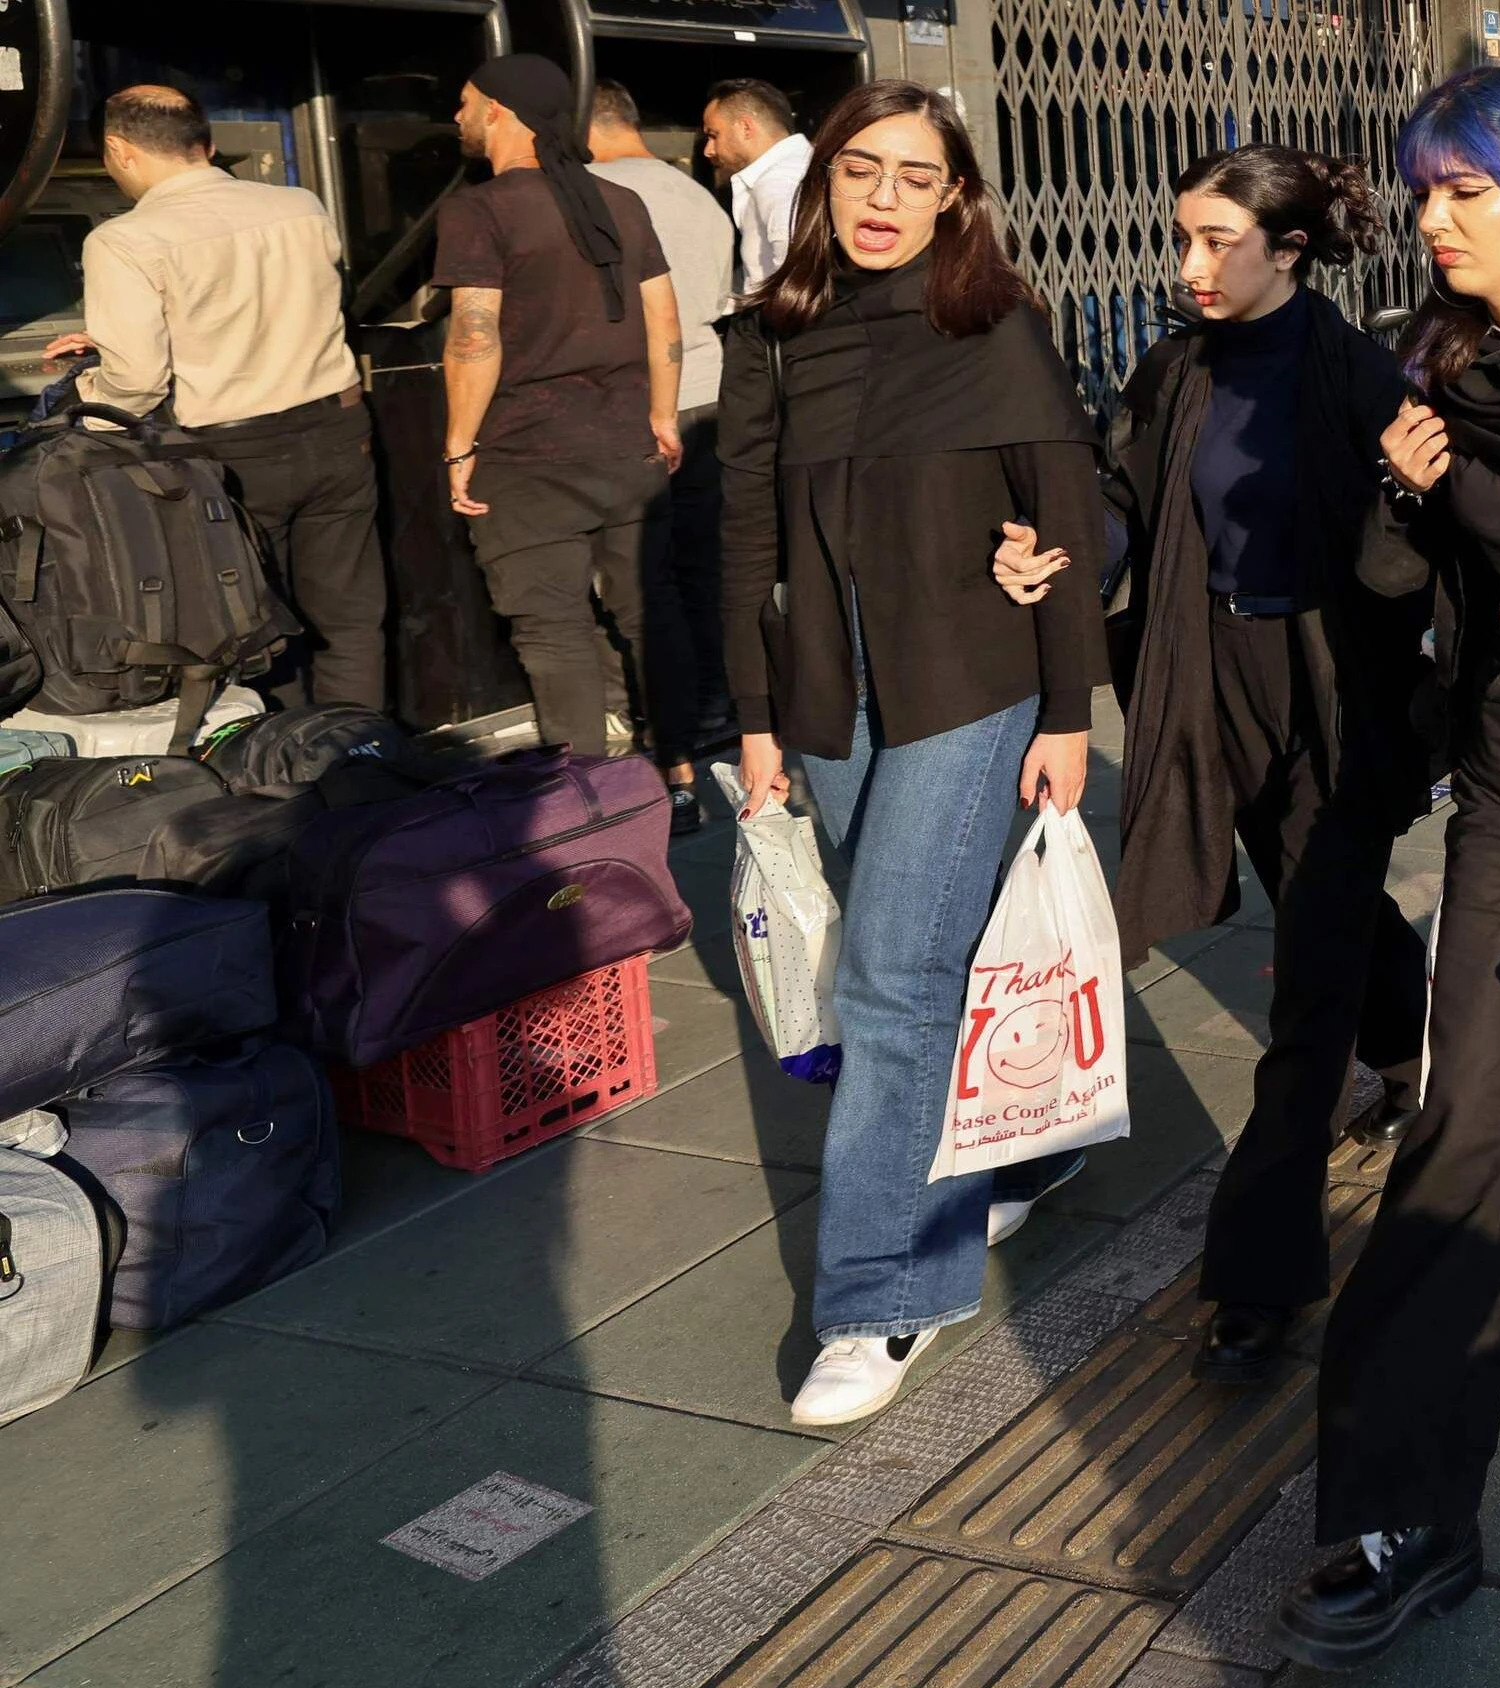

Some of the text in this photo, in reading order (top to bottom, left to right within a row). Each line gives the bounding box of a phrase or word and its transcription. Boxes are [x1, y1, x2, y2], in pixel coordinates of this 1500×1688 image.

[975, 948, 1076, 1004] Thank
[951, 1074, 1116, 1132] ease Come Again
[1021, 1119, 1051, 1136] شما
